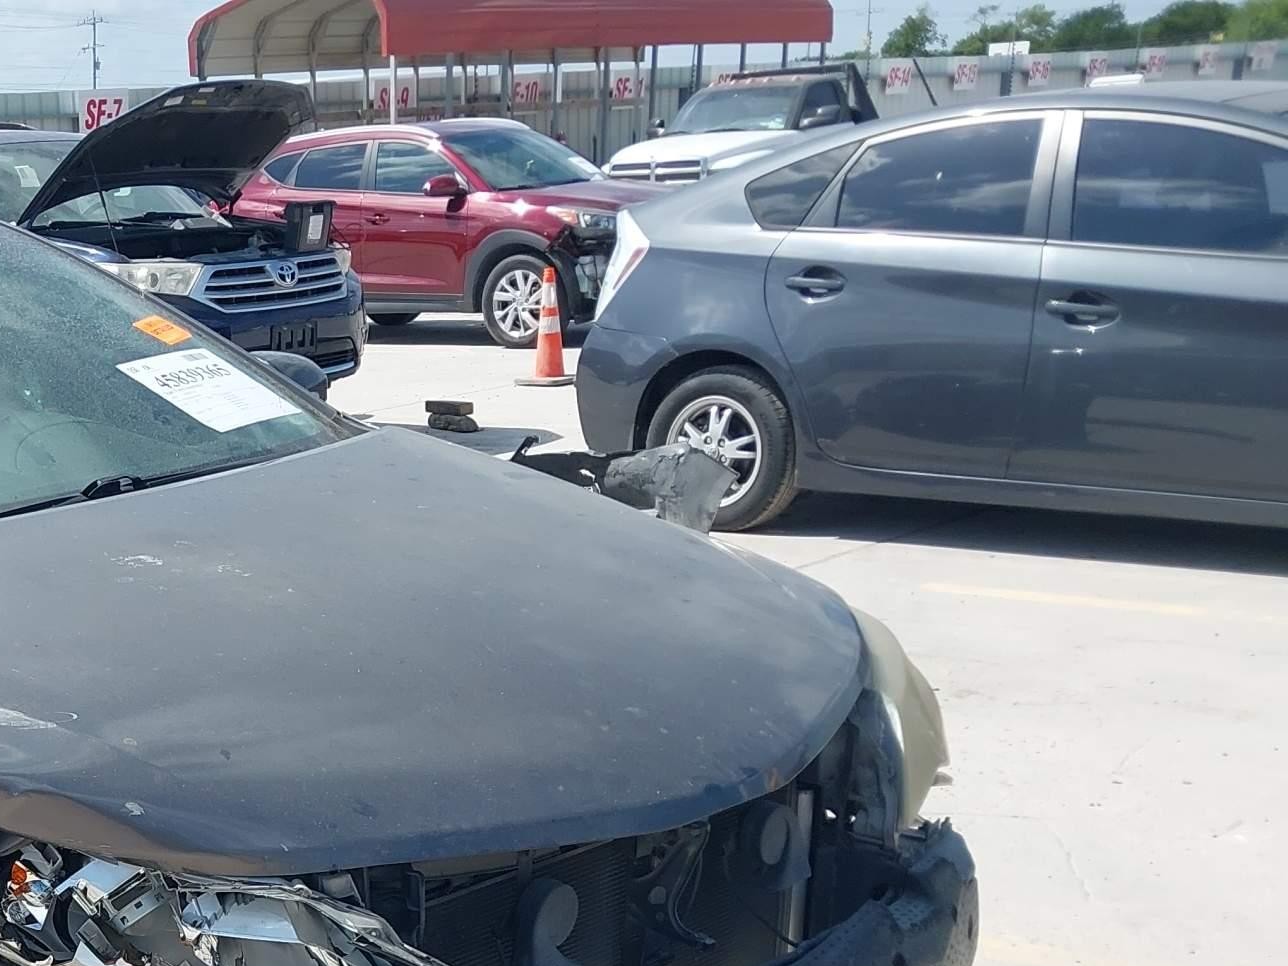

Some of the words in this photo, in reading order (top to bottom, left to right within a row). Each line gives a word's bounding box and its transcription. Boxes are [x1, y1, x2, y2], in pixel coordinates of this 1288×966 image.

[887, 67, 912, 89] SF-14
[85, 98, 123, 130] SF-7
[153, 363, 232, 390] 45839365
